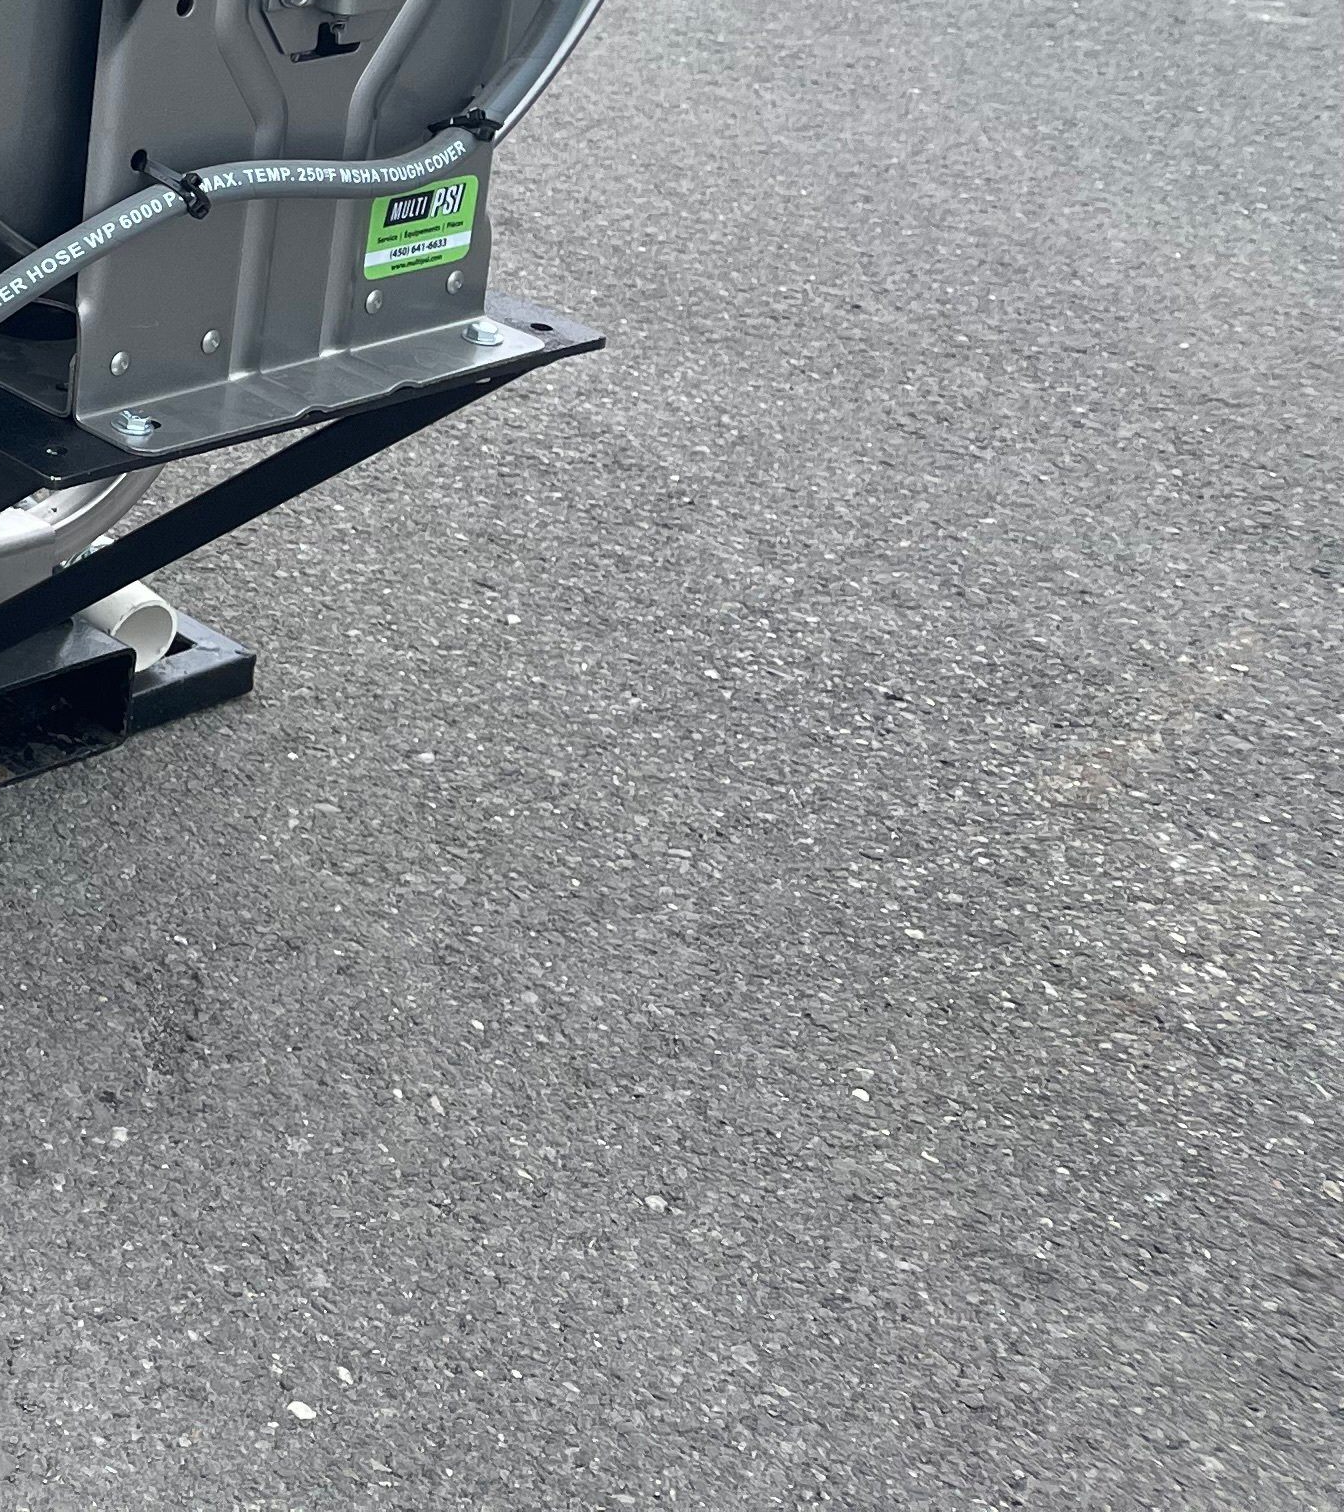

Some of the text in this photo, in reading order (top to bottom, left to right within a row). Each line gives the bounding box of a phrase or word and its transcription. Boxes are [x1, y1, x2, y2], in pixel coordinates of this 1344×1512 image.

[243, 168, 295, 183] TEMP.
[340, 168, 381, 184] MSHA
[380, 161, 426, 182] TOUGH
[424, 140, 467, 172] COVER
[390, 183, 467, 221] MULTI PSI
[26, 240, 87, 285] HOSE
[82, 222, 116, 251] WP
[118, 197, 164, 231] 6000
[389, 238, 447, 260] (450) 641-6633
